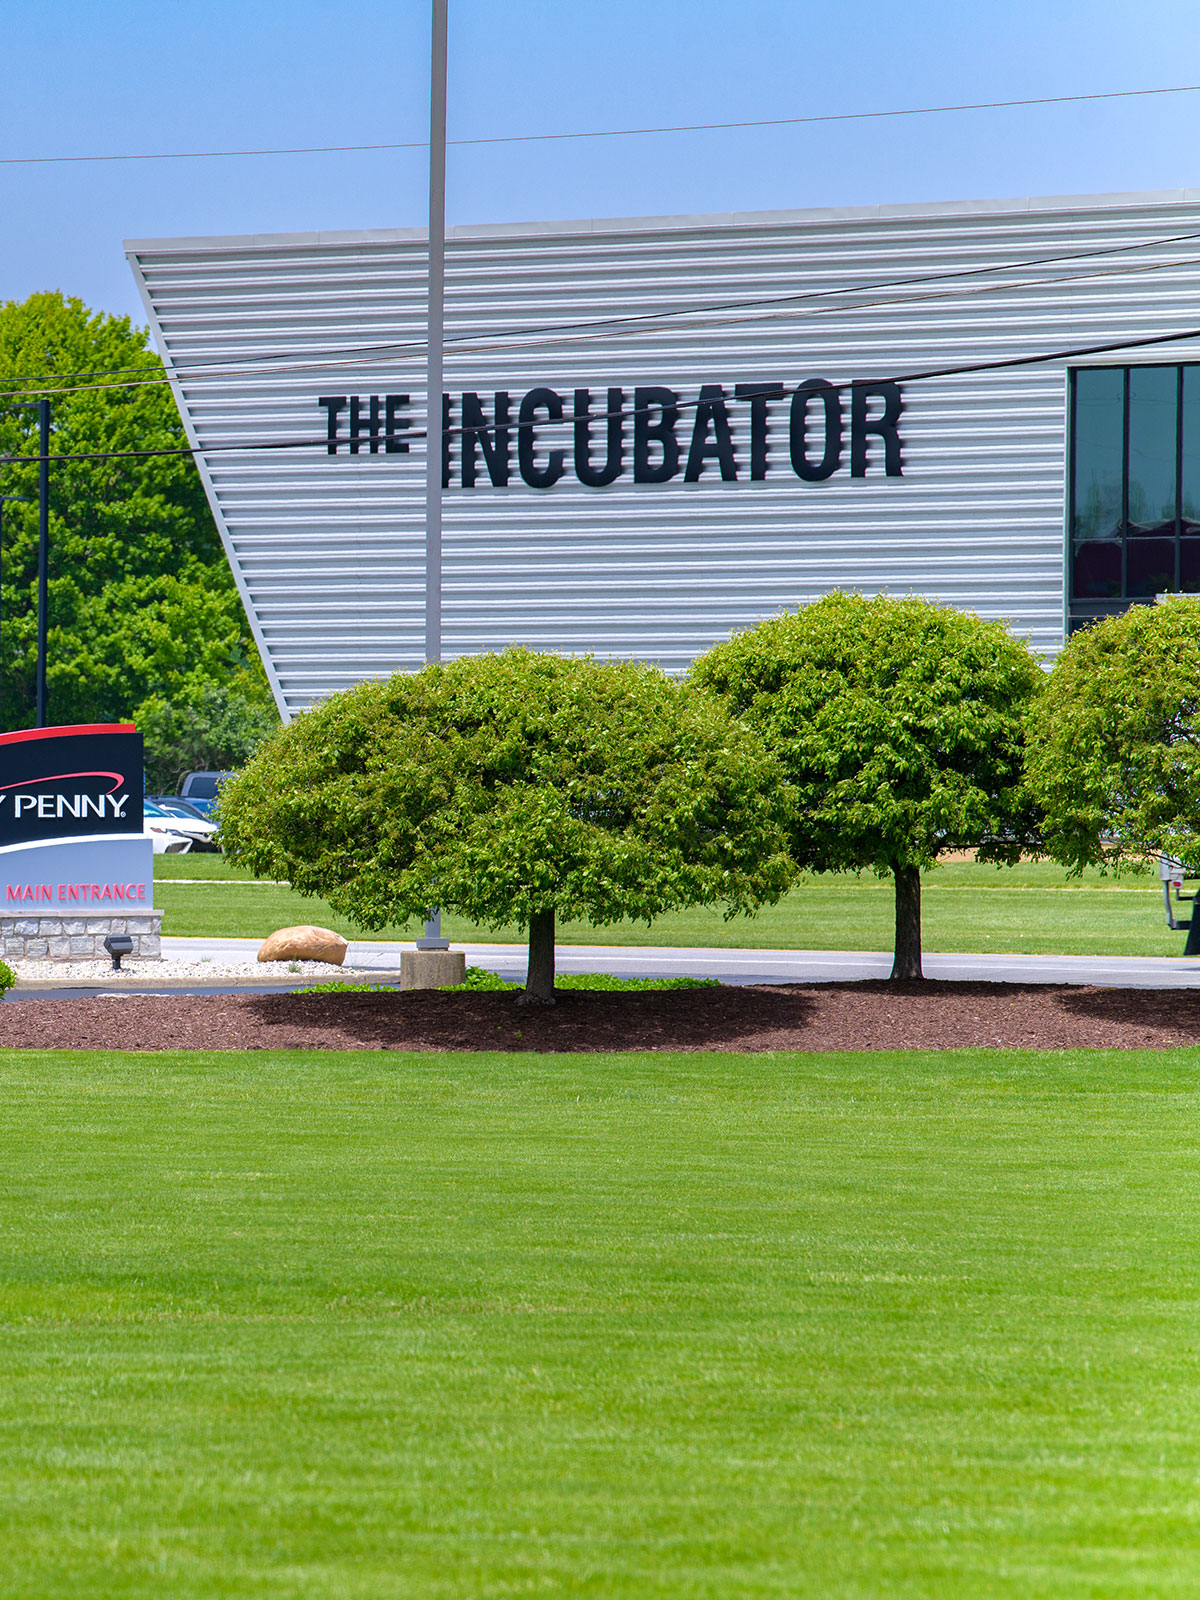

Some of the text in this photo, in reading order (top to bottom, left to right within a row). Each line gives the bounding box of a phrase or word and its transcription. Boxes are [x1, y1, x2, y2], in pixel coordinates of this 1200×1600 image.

[318, 395, 411, 455] THE
[6, 883, 145, 901] MAIN ENTRANCE
